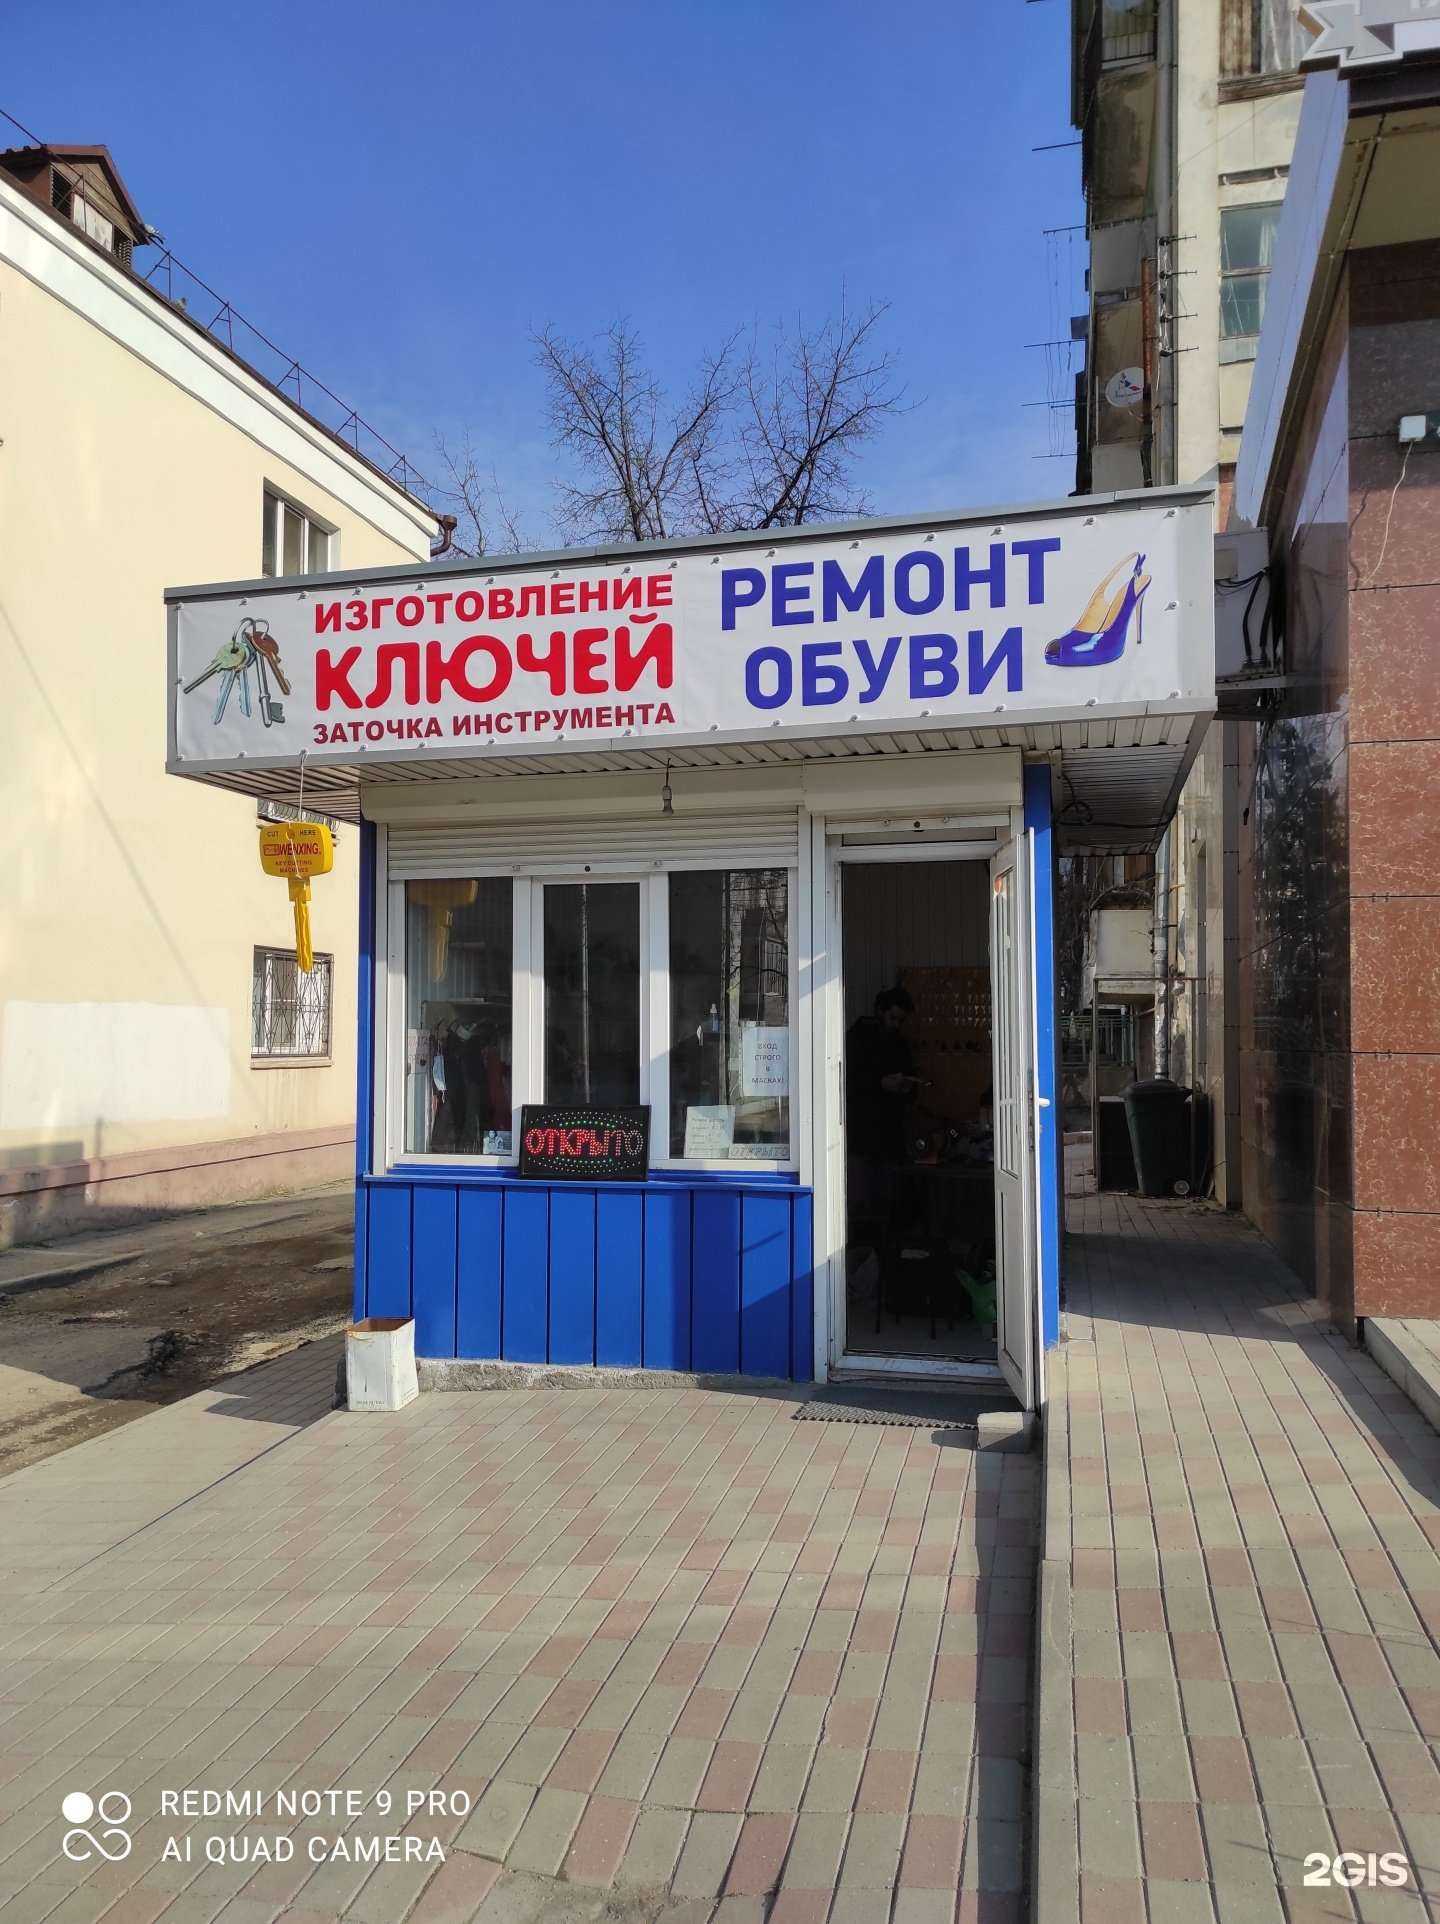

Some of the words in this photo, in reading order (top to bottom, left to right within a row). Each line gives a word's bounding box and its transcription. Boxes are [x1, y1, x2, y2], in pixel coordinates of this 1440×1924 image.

[315, 574, 673, 634] ИЗГОТОВЛЕНИЕ
[722, 537, 1061, 631] РЕМОНТ
[315, 612, 674, 712] КЛЮЧЕЙ
[745, 627, 1024, 710] ОБУВИ
[313, 715, 442, 744] ЗАТОЧКА
[453, 702, 675, 736] ИНСТРУМЕНТА
[524, 1128, 645, 1156] ОТКРЫТО
